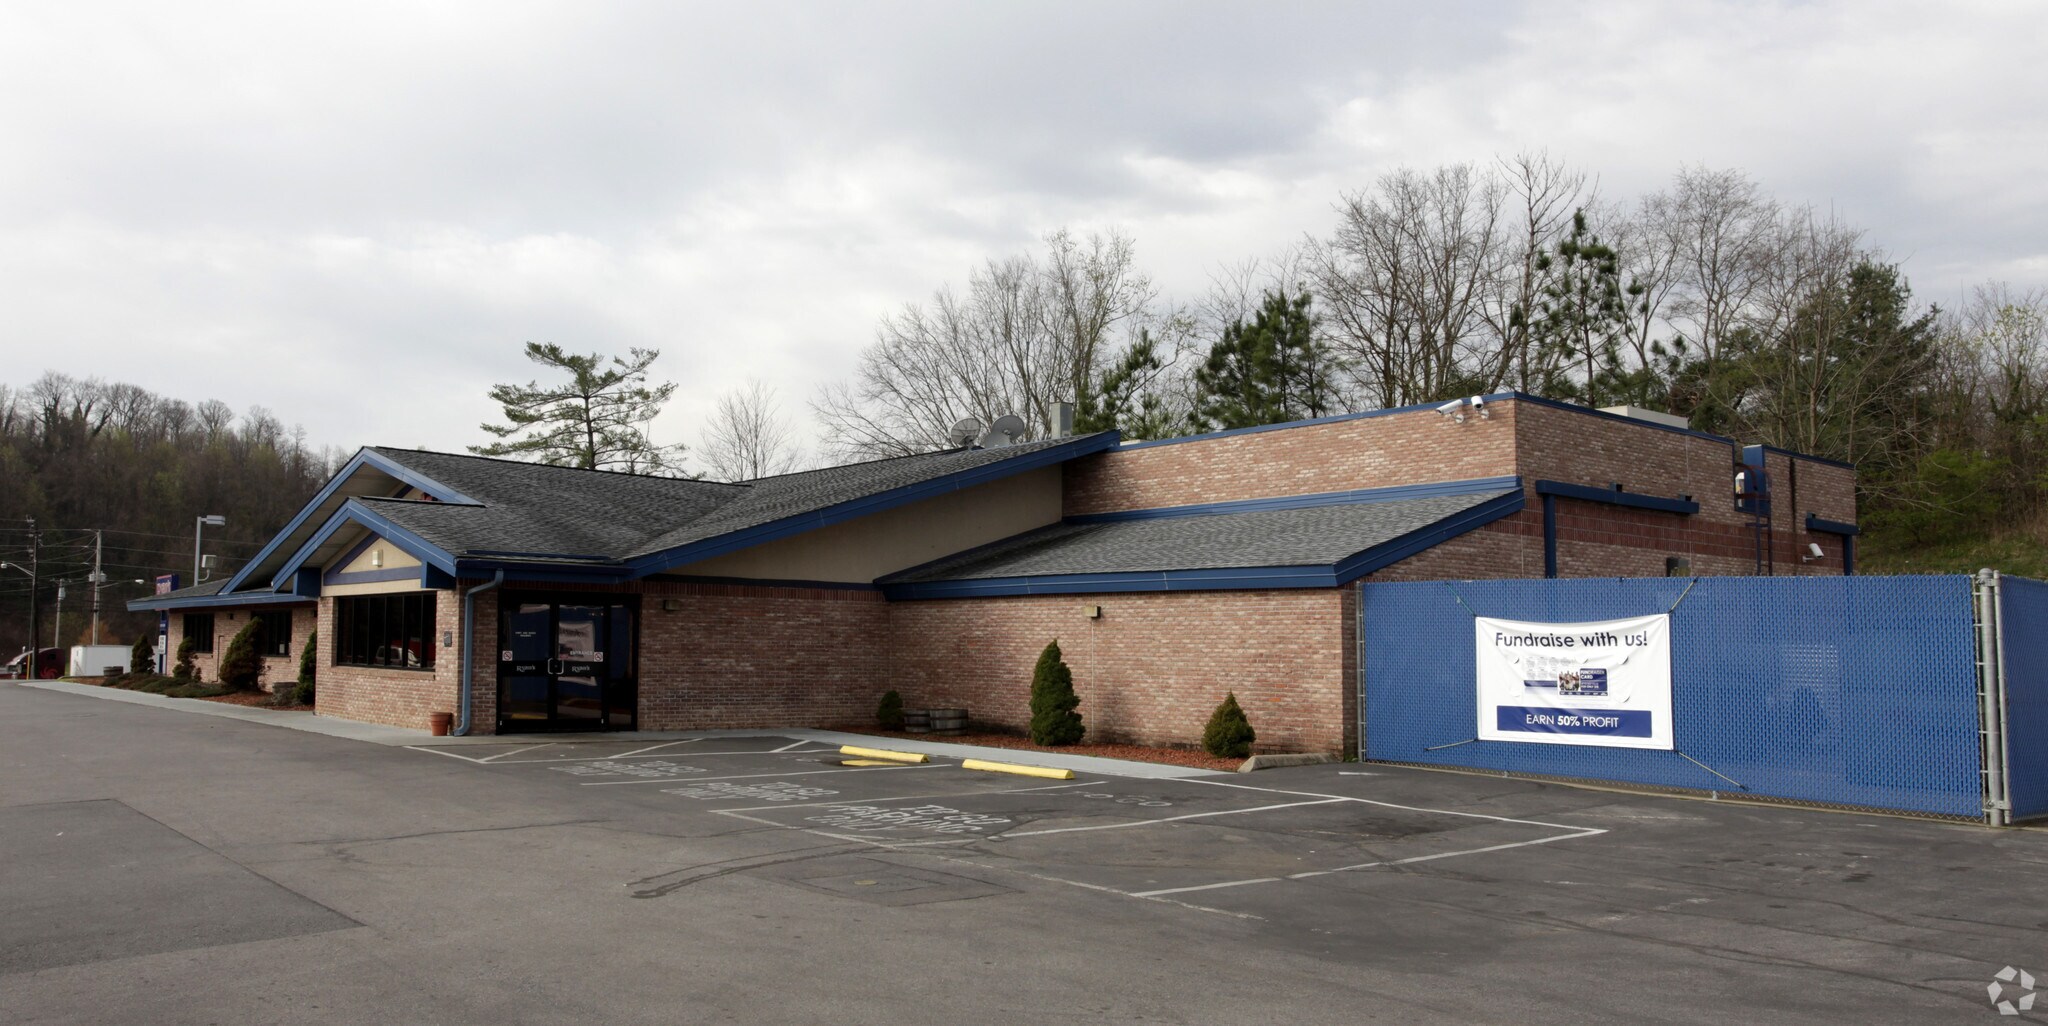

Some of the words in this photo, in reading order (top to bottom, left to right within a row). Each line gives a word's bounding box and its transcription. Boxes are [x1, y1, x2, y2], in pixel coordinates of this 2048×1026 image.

[1495, 632, 1575, 648] Fundraise
[1580, 631, 1618, 647] with
[1625, 630, 1648, 647] us!
[516, 664, 536, 673] Ryan's
[571, 665, 590, 673] Ryan's
[1526, 714, 1555, 725] EARN
[1557, 715, 1580, 726] 50%
[1582, 716, 1619, 728] PROFIT
[688, 782, 810, 801] PARKING
[829, 805, 983, 833] PARKING
[899, 804, 960, 815] TO
[943, 814, 1011, 825] GO
[804, 815, 897, 832] ONLY
